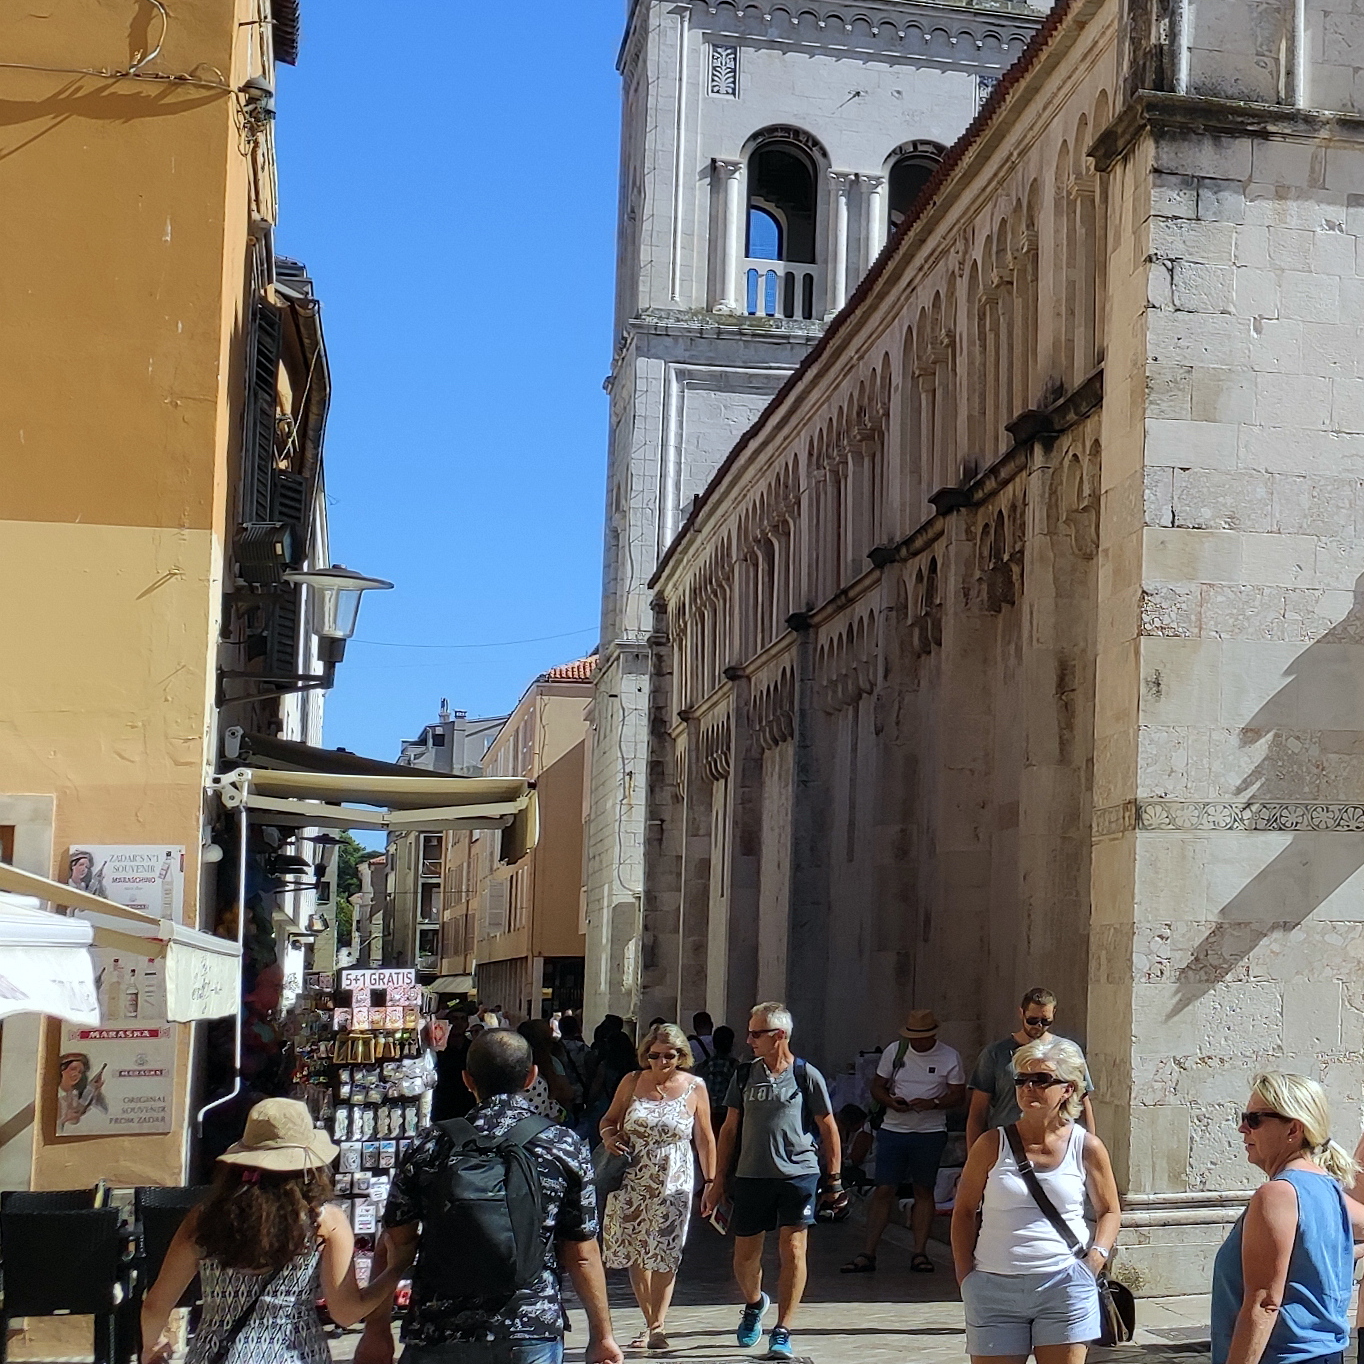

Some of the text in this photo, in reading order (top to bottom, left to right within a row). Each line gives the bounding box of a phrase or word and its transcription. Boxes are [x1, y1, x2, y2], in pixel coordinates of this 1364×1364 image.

[112, 864, 156, 874] SOUVENIR
[345, 971, 413, 986] 5+1 GRATIS
[88, 1029, 150, 1039] MARASKA
[122, 1096, 166, 1104] ORIGINAL
[121, 1106, 166, 1114] SOUVENIR
[109, 1116, 166, 1125] FROM ZADAR
